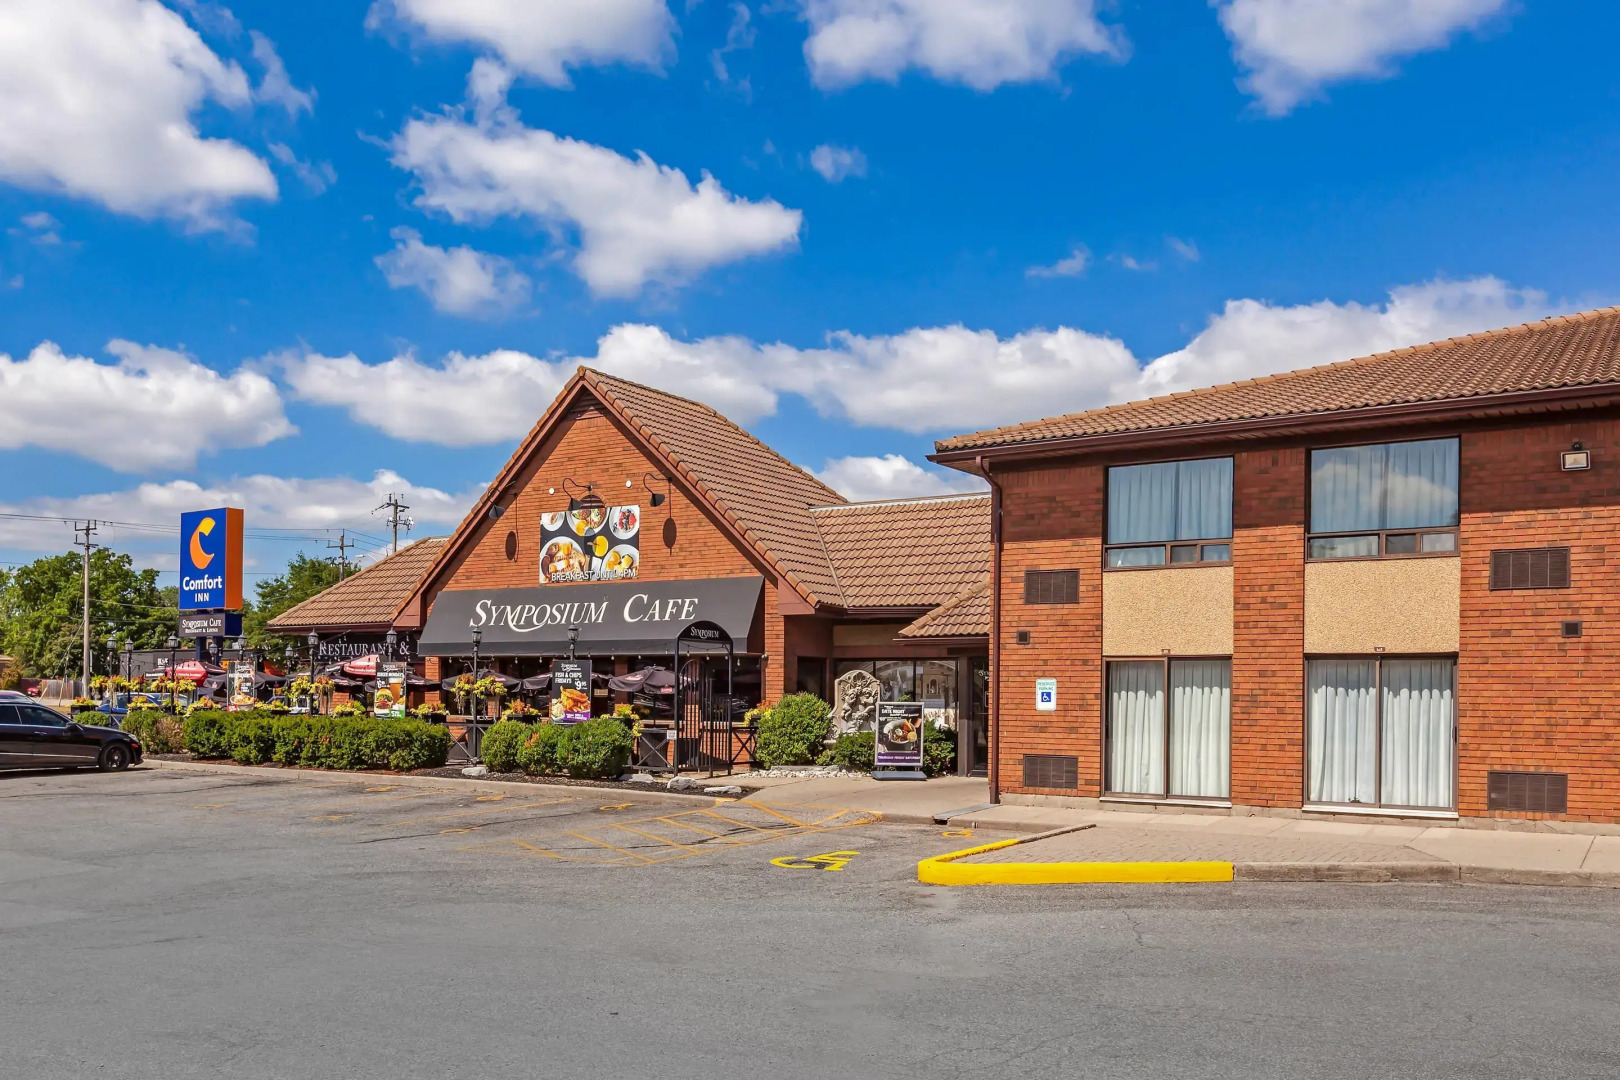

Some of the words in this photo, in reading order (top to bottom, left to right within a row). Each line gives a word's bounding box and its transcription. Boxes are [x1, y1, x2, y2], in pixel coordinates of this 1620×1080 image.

[551, 571, 593, 582] BREAKFAST
[596, 570, 617, 580] UNTIL
[619, 568, 636, 578] 4PM
[182, 574, 223, 591] Comfort
[194, 592, 210, 602] INN
[469, 599, 609, 633] SYMPOSIUM
[623, 593, 699, 623] CAFE
[182, 619, 208, 629] SYMPOSIUM
[209, 618, 222, 627] CAFE
[690, 626, 720, 639] SYMPOSIUM
[319, 641, 394, 656] RESTAURANT
[399, 641, 410, 655] &
